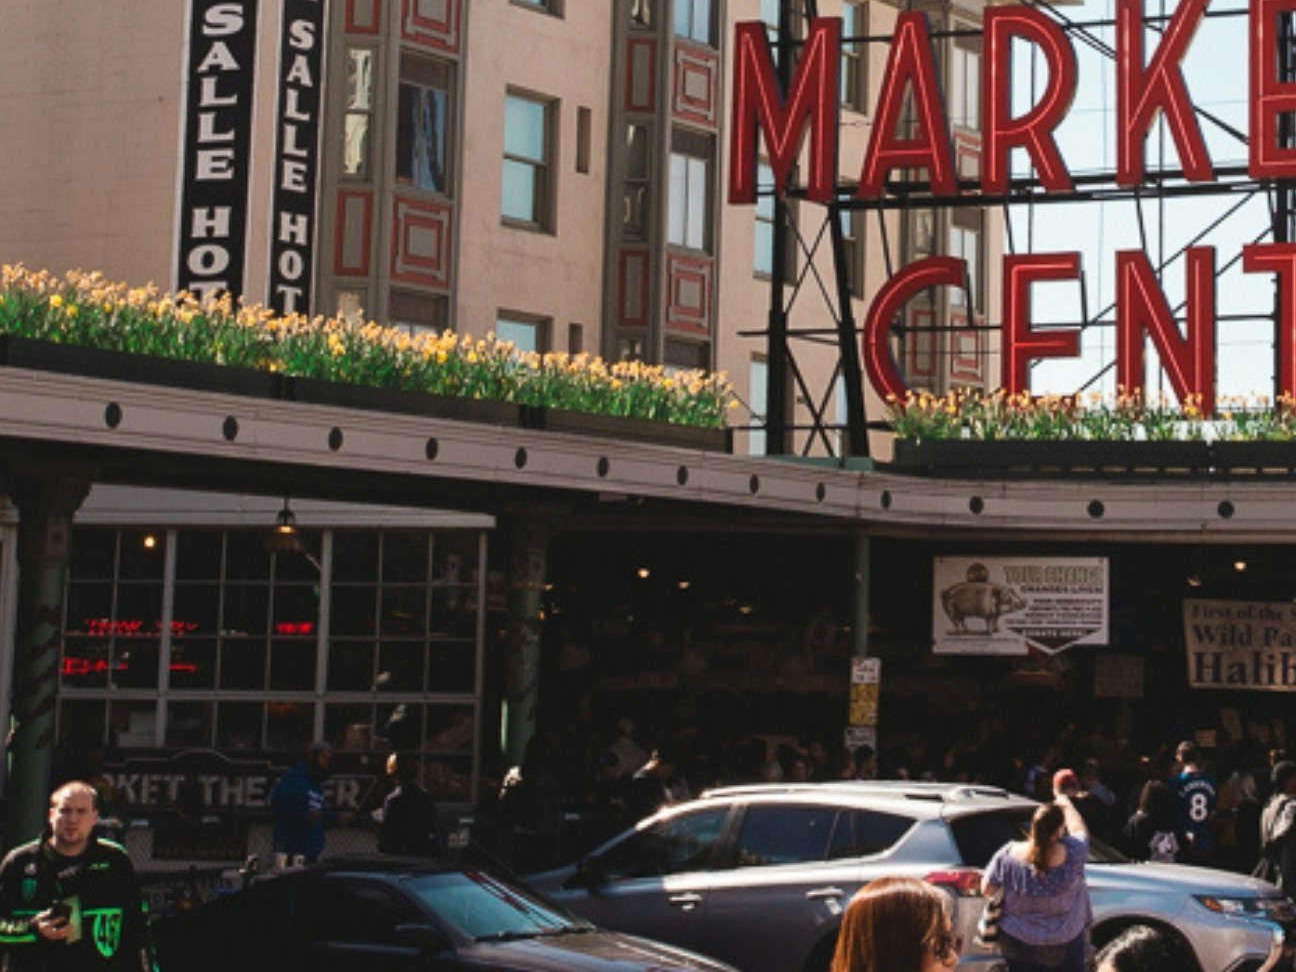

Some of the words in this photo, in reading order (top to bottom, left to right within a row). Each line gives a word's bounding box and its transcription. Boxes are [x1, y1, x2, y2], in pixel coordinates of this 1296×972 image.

[1192, 604, 1231, 618] First
[1236, 605, 1253, 619] of
[1259, 605, 1283, 621] the
[1191, 624, 1252, 647] Wild
[1190, 793, 1208, 822] 8
